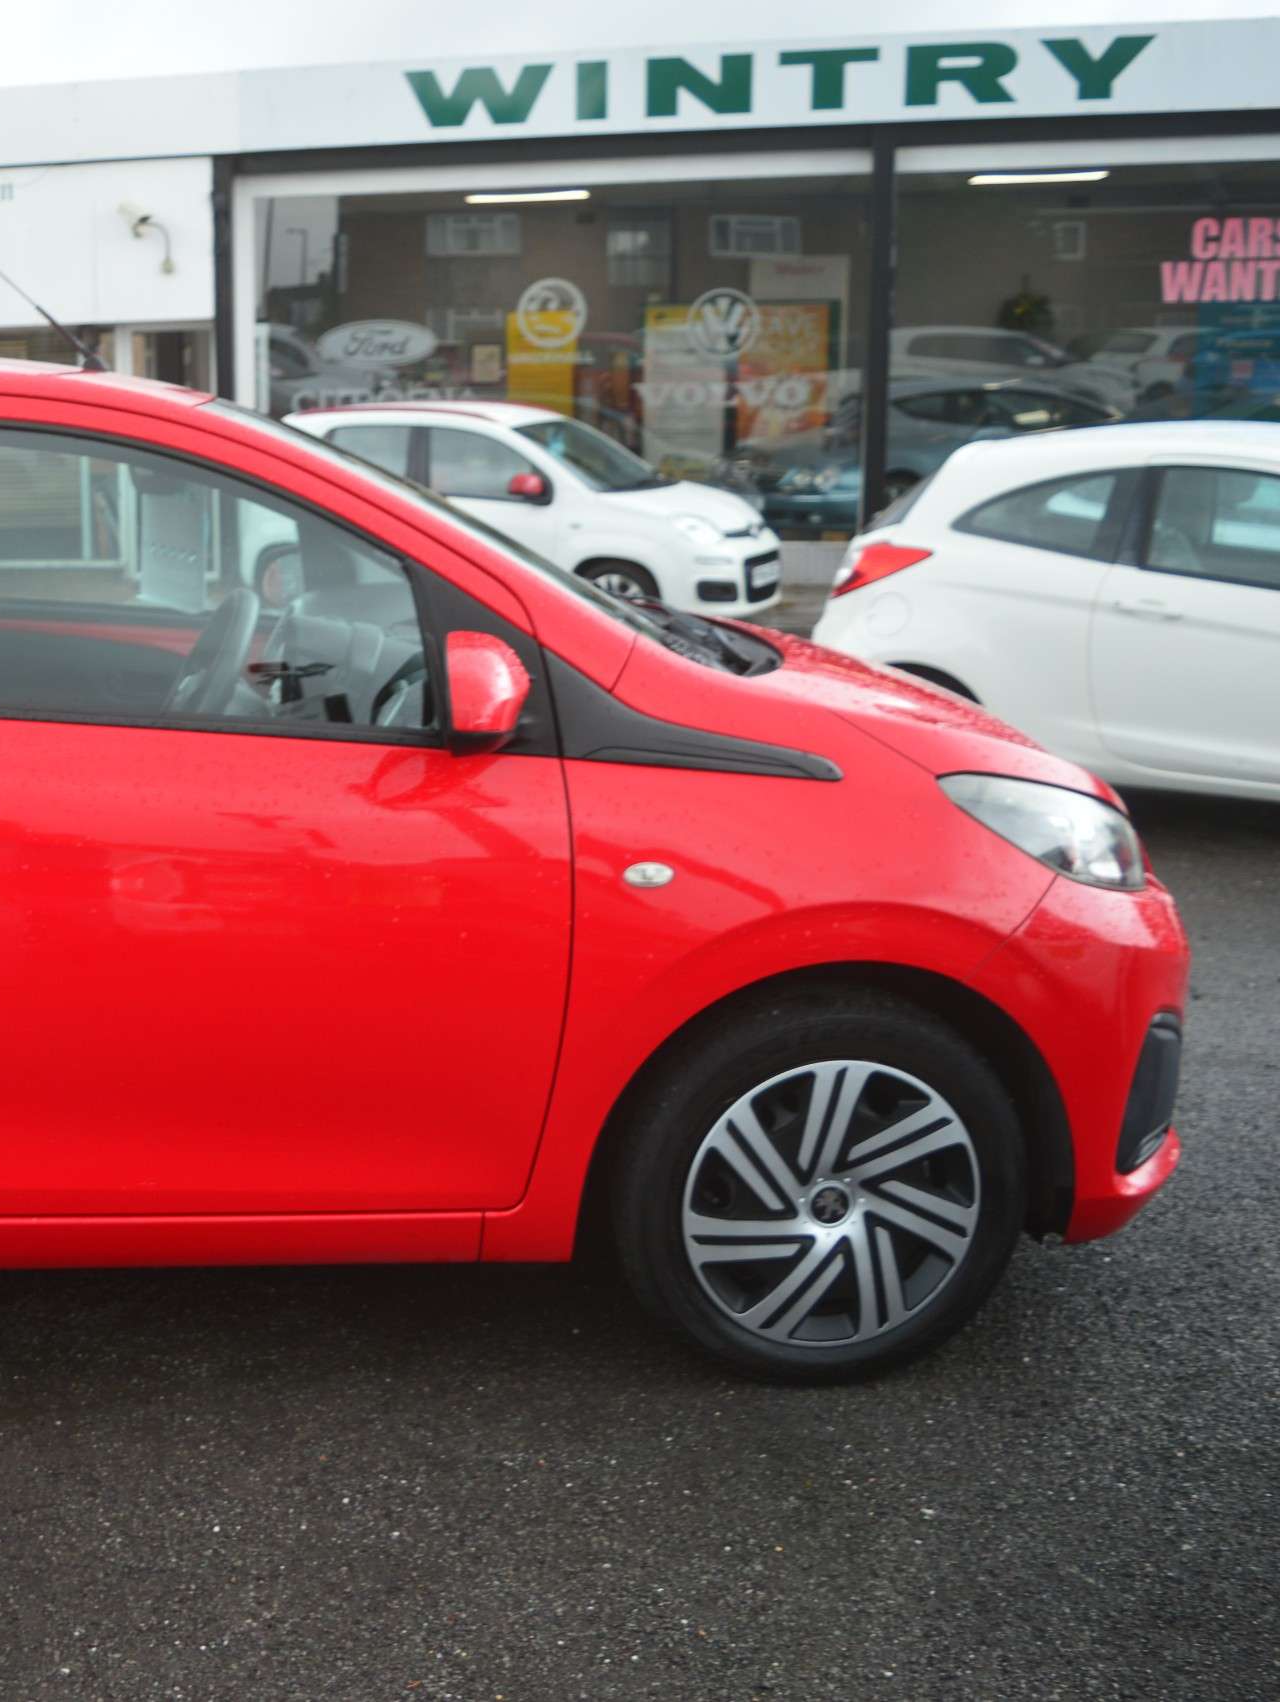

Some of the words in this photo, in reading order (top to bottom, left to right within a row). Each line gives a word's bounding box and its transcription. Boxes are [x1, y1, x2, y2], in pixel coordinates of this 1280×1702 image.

[404, 33, 1158, 128] WINTRY
[344, 329, 410, 357] Ford
[632, 375, 813, 409] VOLVO
